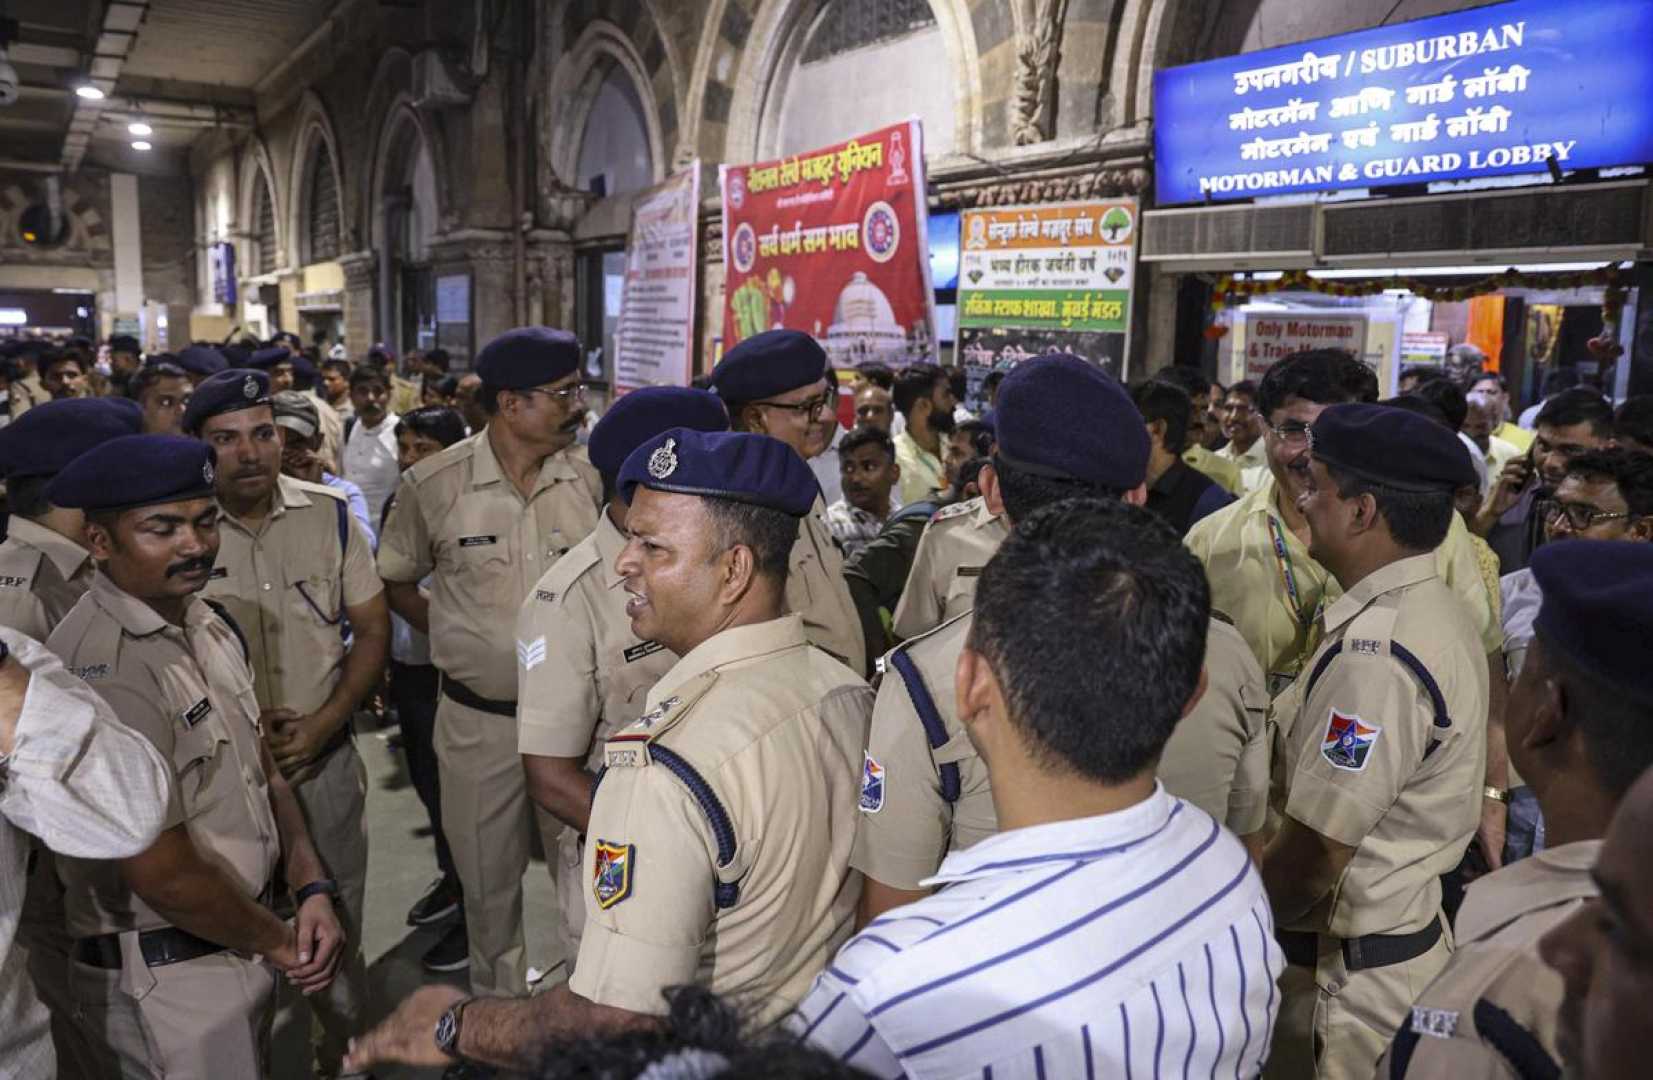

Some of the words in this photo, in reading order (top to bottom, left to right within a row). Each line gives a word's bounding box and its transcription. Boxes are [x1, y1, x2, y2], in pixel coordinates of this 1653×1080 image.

[1233, 52, 1341, 94] उपनगरीय
[1344, 51, 1356, 77] /
[1361, 22, 1526, 74] SUBURBAN
[1328, 86, 1396, 118] आणि
[1406, 75, 1457, 104] गार्ड
[1463, 64, 1531, 98] लॉबी
[1240, 131, 1332, 160] मोटरमेन
[1341, 121, 1380, 149] एवं
[1390, 113, 1440, 143] गार्ड
[1446, 105, 1512, 137] लॉबी
[1199, 166, 1333, 193] MOTORMAN
[1338, 163, 1359, 181] &
[1363, 152, 1461, 178] GUARD
[1469, 141, 1576, 168] LOBBY
[830, 222, 860, 250] भाव
[1091, 293, 1122, 319] मंडल
[1248, 342, 1258, 357] &
[1256, 321, 1281, 339] Only
[1287, 322, 1353, 337] Motorman
